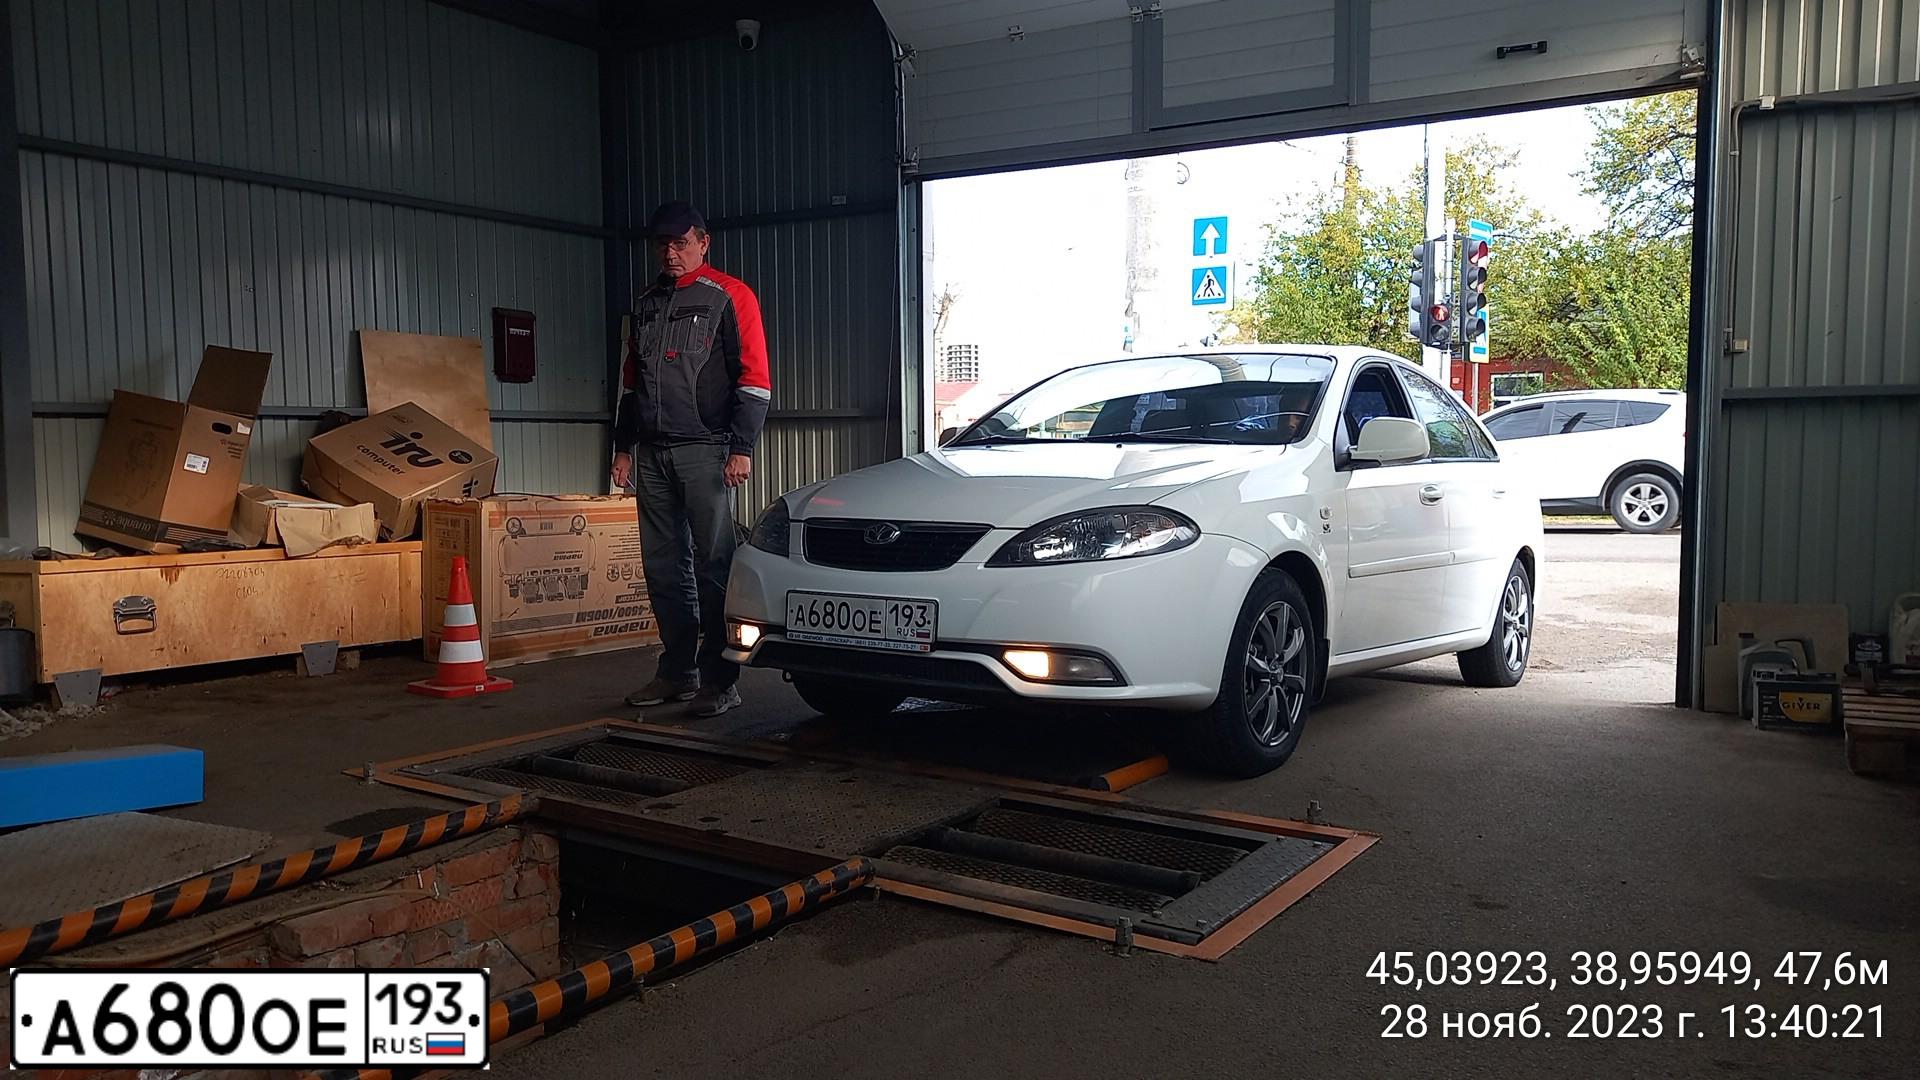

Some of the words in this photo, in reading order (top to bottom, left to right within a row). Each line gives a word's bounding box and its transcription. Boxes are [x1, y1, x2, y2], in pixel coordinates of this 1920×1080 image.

[356, 444, 407, 475] computer
[889, 604, 927, 627] 193
[896, 628, 916, 637] RUS
[1782, 702, 1821, 711] GIVER
